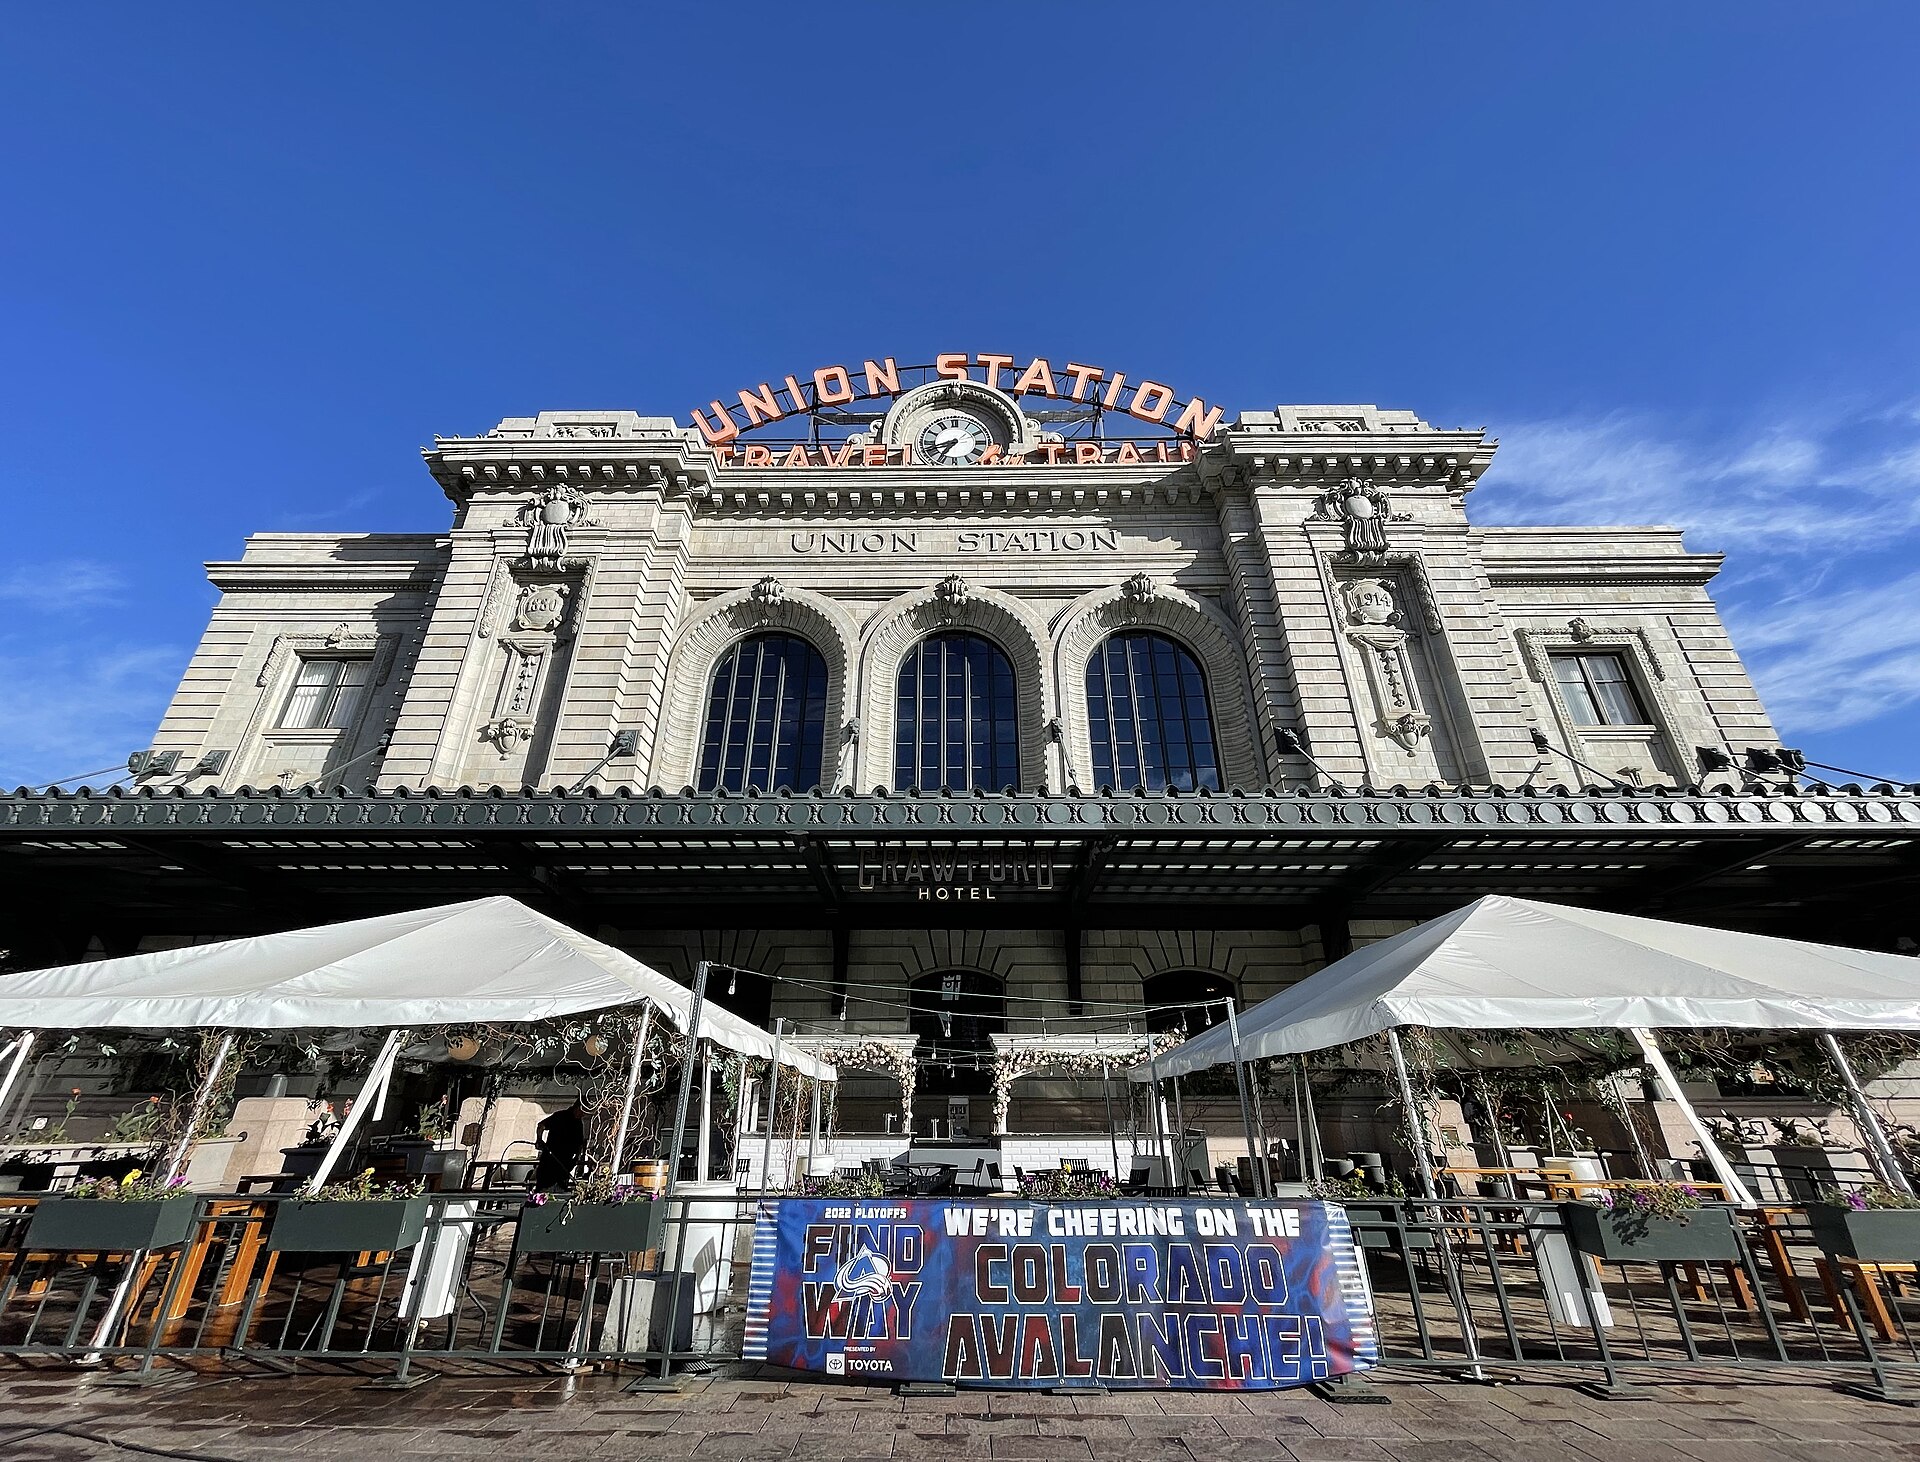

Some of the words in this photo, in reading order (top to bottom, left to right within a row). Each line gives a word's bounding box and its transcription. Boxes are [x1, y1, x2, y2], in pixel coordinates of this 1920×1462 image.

[689, 357, 903, 445] UNION
[936, 353, 1226, 443] STATION
[790, 532, 919, 554] UNION
[957, 530, 1118, 553] STATION
[1354, 592, 1391, 608] 1914
[859, 847, 1053, 890] CRAWFORD
[918, 887, 996, 900] HOTEL
[824, 1207, 851, 1218] 2022
[855, 1207, 907, 1218] PLAYOFFS
[943, 1207, 1035, 1238] WE'RE
[1047, 1207, 1184, 1237] CHEERING
[1197, 1207, 1242, 1236] ON
[1252, 1206, 1301, 1238] THE
[803, 1224, 924, 1274] FIND
[974, 1241, 1290, 1306] COLORADO
[802, 1281, 923, 1340] WAY
[848, 1359, 893, 1371] TOYOTA
[942, 1312, 1328, 1381] AVALANCHE!
